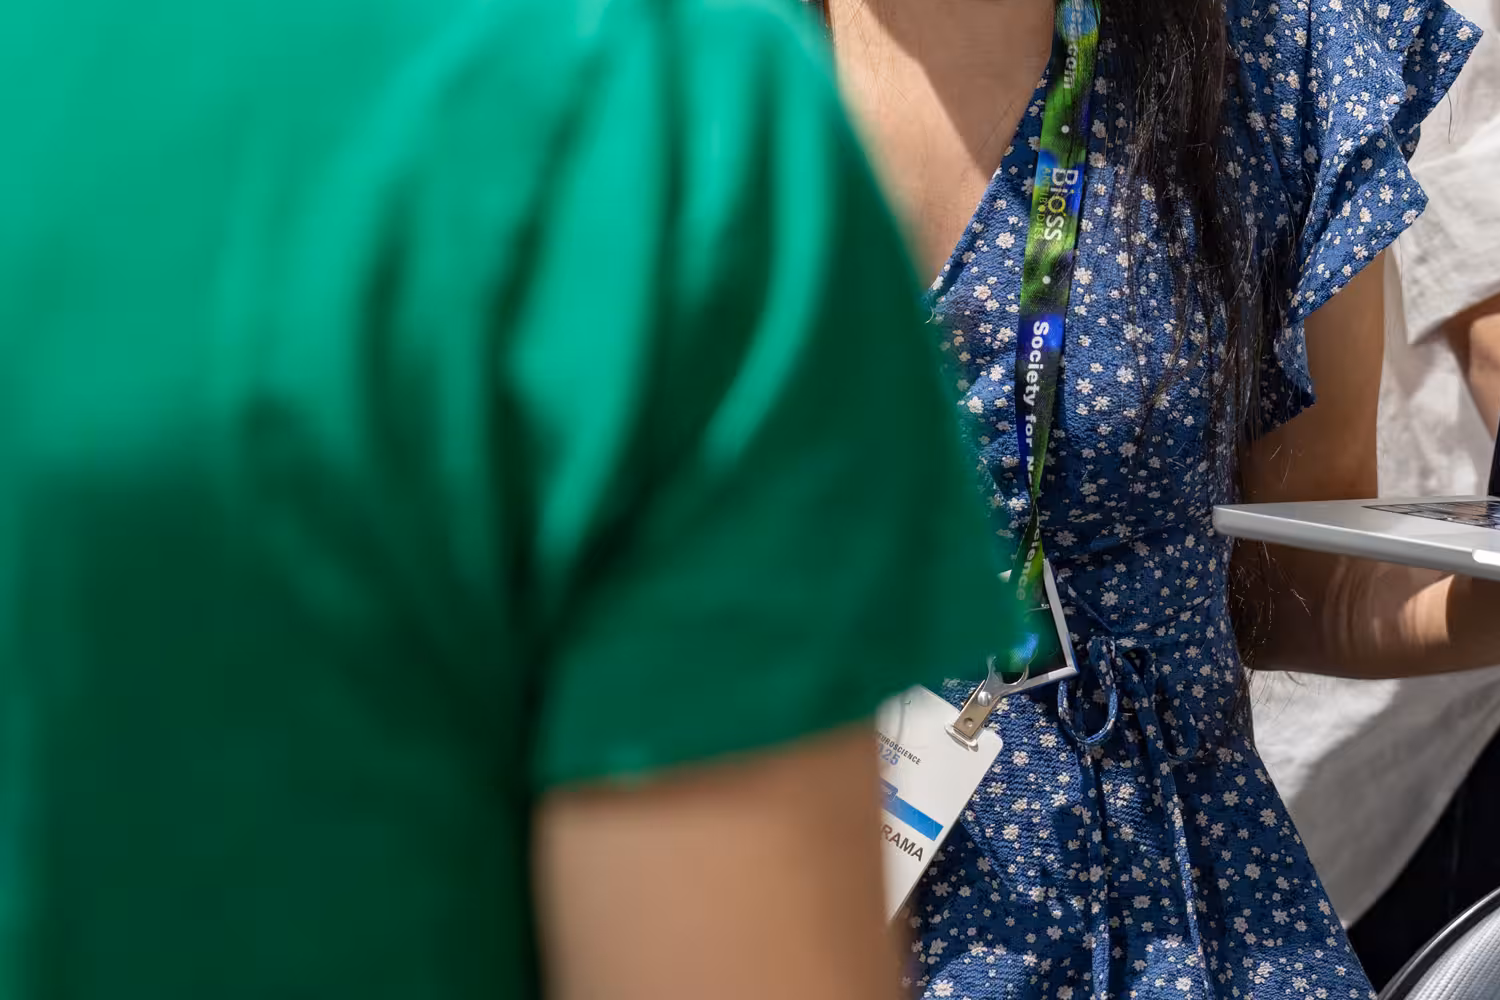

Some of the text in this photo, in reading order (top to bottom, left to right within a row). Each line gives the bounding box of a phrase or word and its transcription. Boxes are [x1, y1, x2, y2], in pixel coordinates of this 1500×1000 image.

[1022, 320, 1050, 406] Society
[1025, 415, 1037, 448] for
[877, 731, 922, 766] EUROSCIENCE
